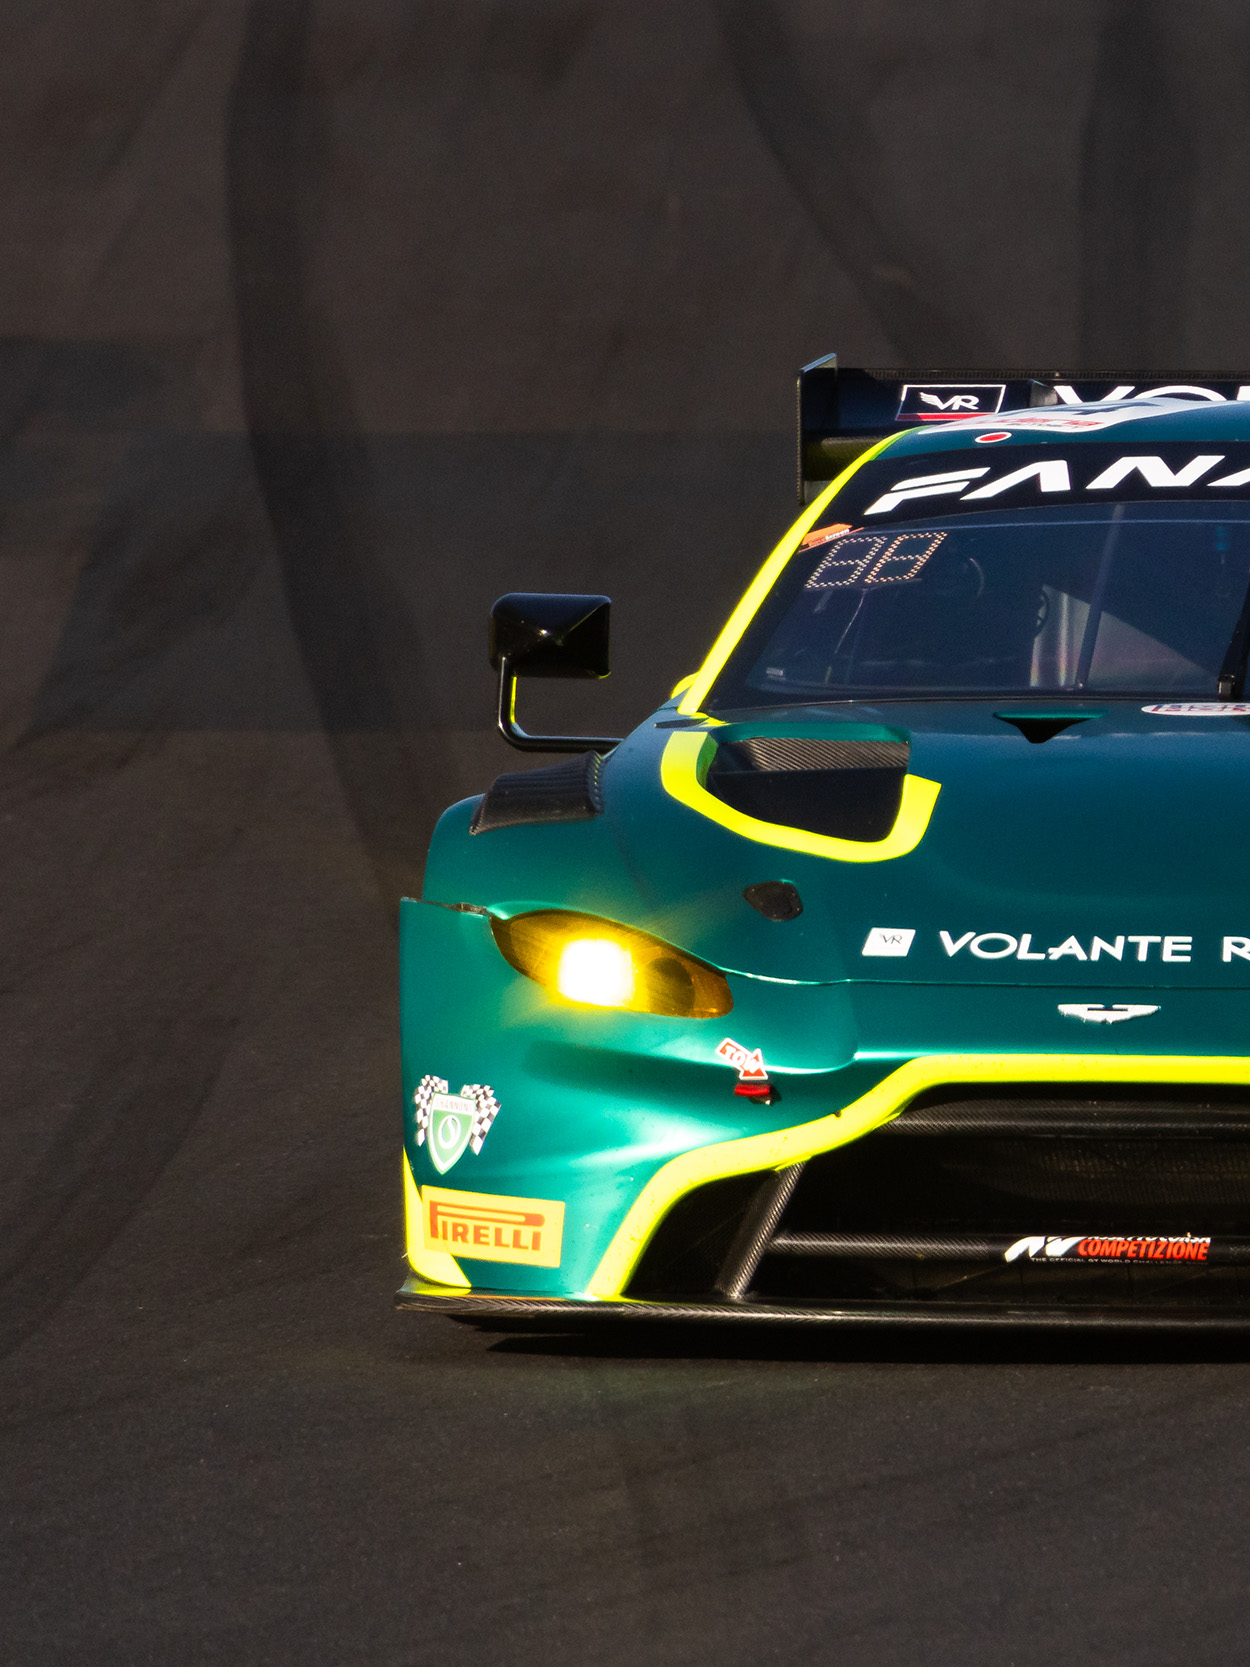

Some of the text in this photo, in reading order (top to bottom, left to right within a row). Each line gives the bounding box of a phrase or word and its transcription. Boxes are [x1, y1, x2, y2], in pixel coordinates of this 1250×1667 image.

[920, 391, 980, 411] VR
[804, 531, 948, 589] 88
[880, 932, 904, 945] VR
[938, 929, 1193, 963] VOLANTE
[723, 1044, 765, 1074] TOW
[429, 1199, 546, 1252] PIRELLI
[1077, 1238, 1210, 1261] COMPETIZIONE
